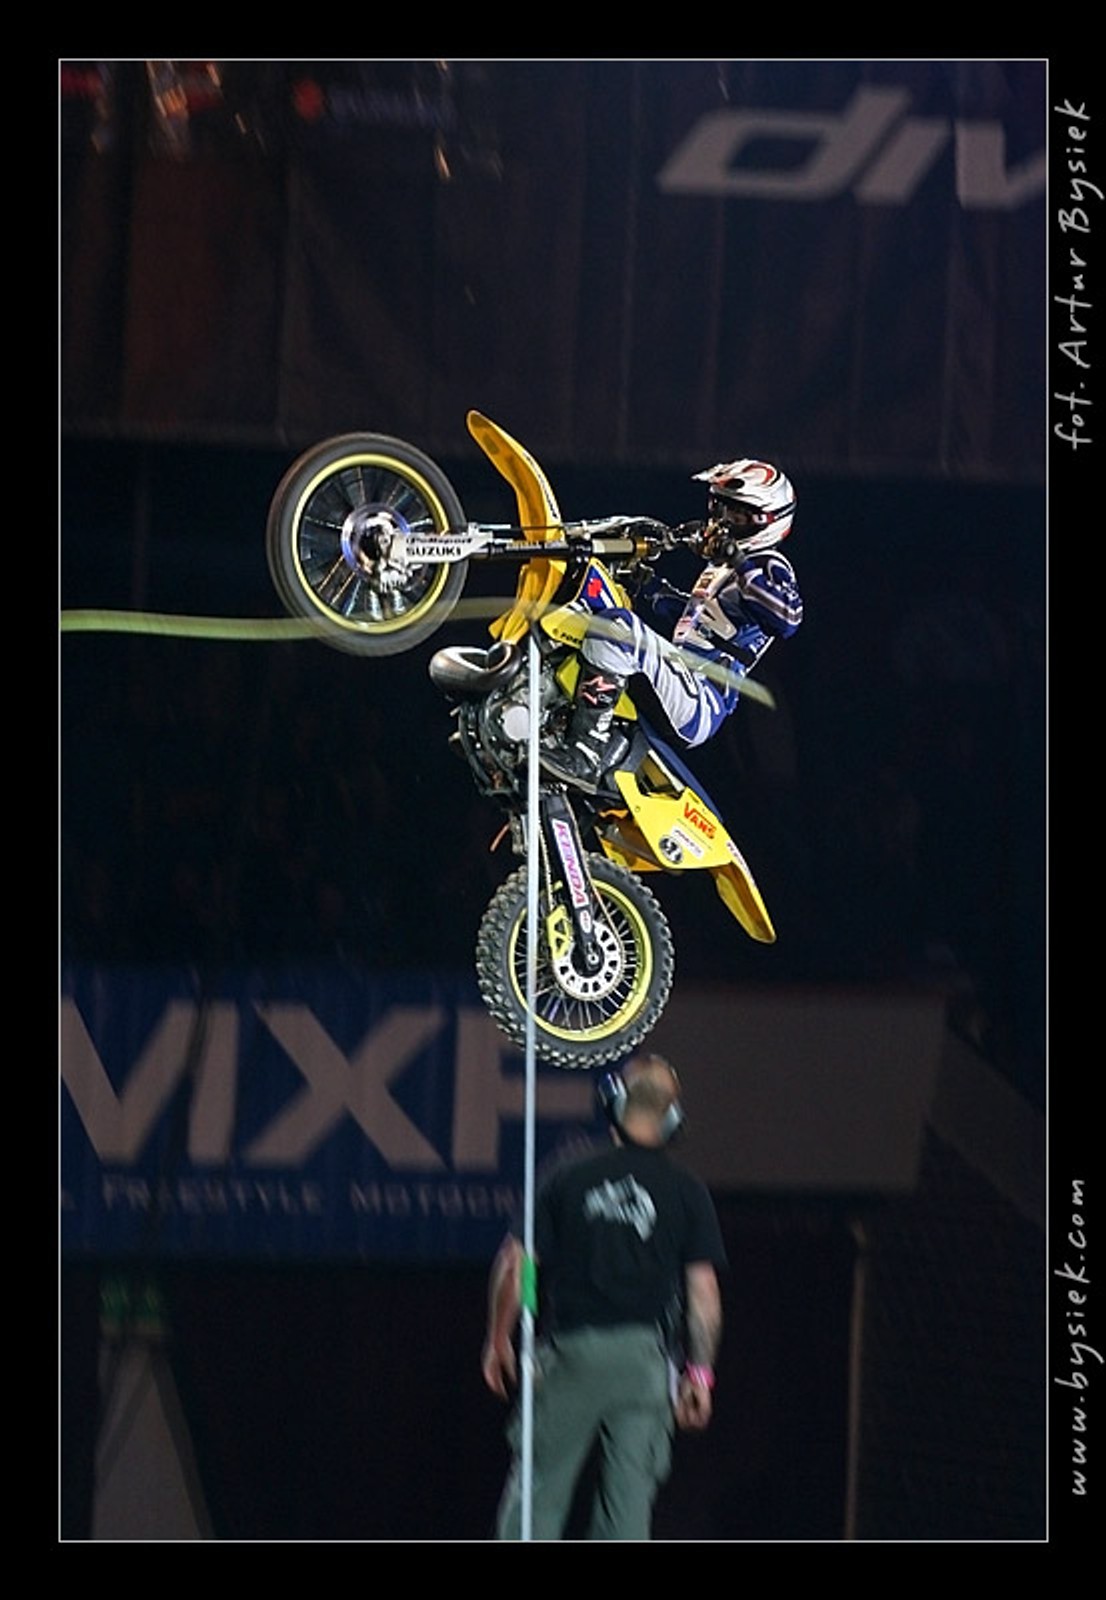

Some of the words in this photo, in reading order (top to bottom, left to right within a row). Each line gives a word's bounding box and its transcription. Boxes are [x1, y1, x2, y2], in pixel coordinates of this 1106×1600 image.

[406, 546, 462, 556] SUZUKI
[683, 802, 717, 839] VANS
[554, 821, 587, 905] KENDA
